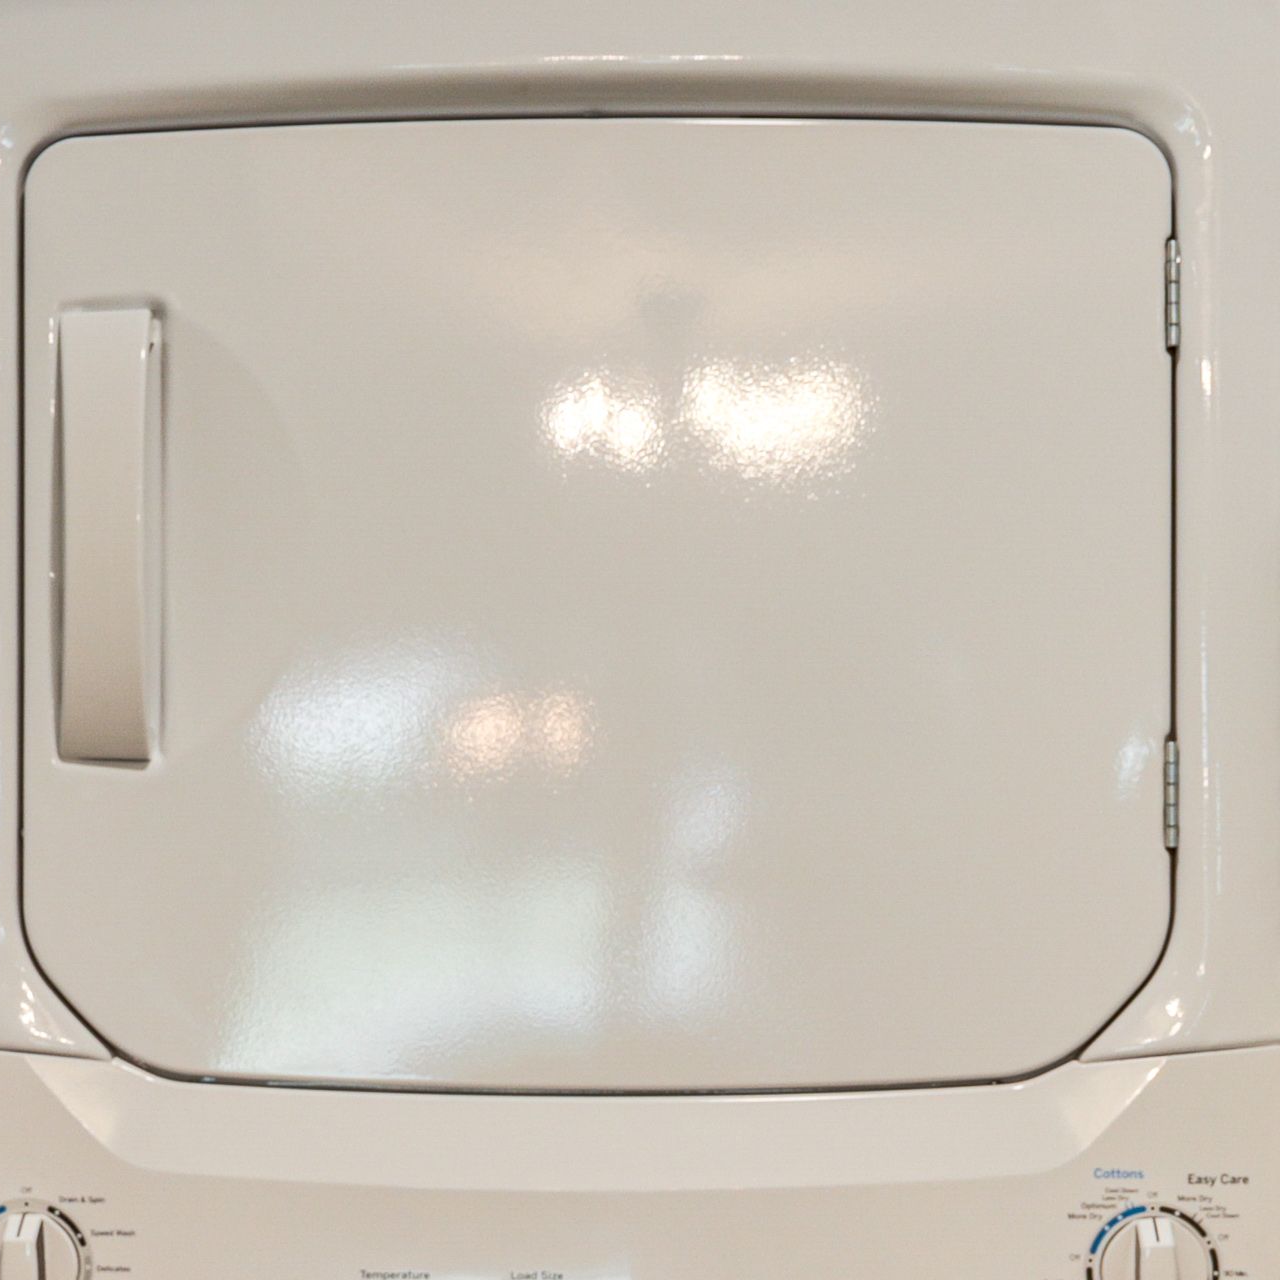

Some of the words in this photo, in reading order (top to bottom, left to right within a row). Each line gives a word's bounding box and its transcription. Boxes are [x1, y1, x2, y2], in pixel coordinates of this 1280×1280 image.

[1094, 1168, 1144, 1179] Cottons
[1186, 1173, 1216, 1188] Easy
[1220, 1173, 1249, 1185] Care
[360, 1269, 431, 1280] Temperature
[511, 1271, 538, 1280] Load
[541, 1271, 563, 1280] Size
